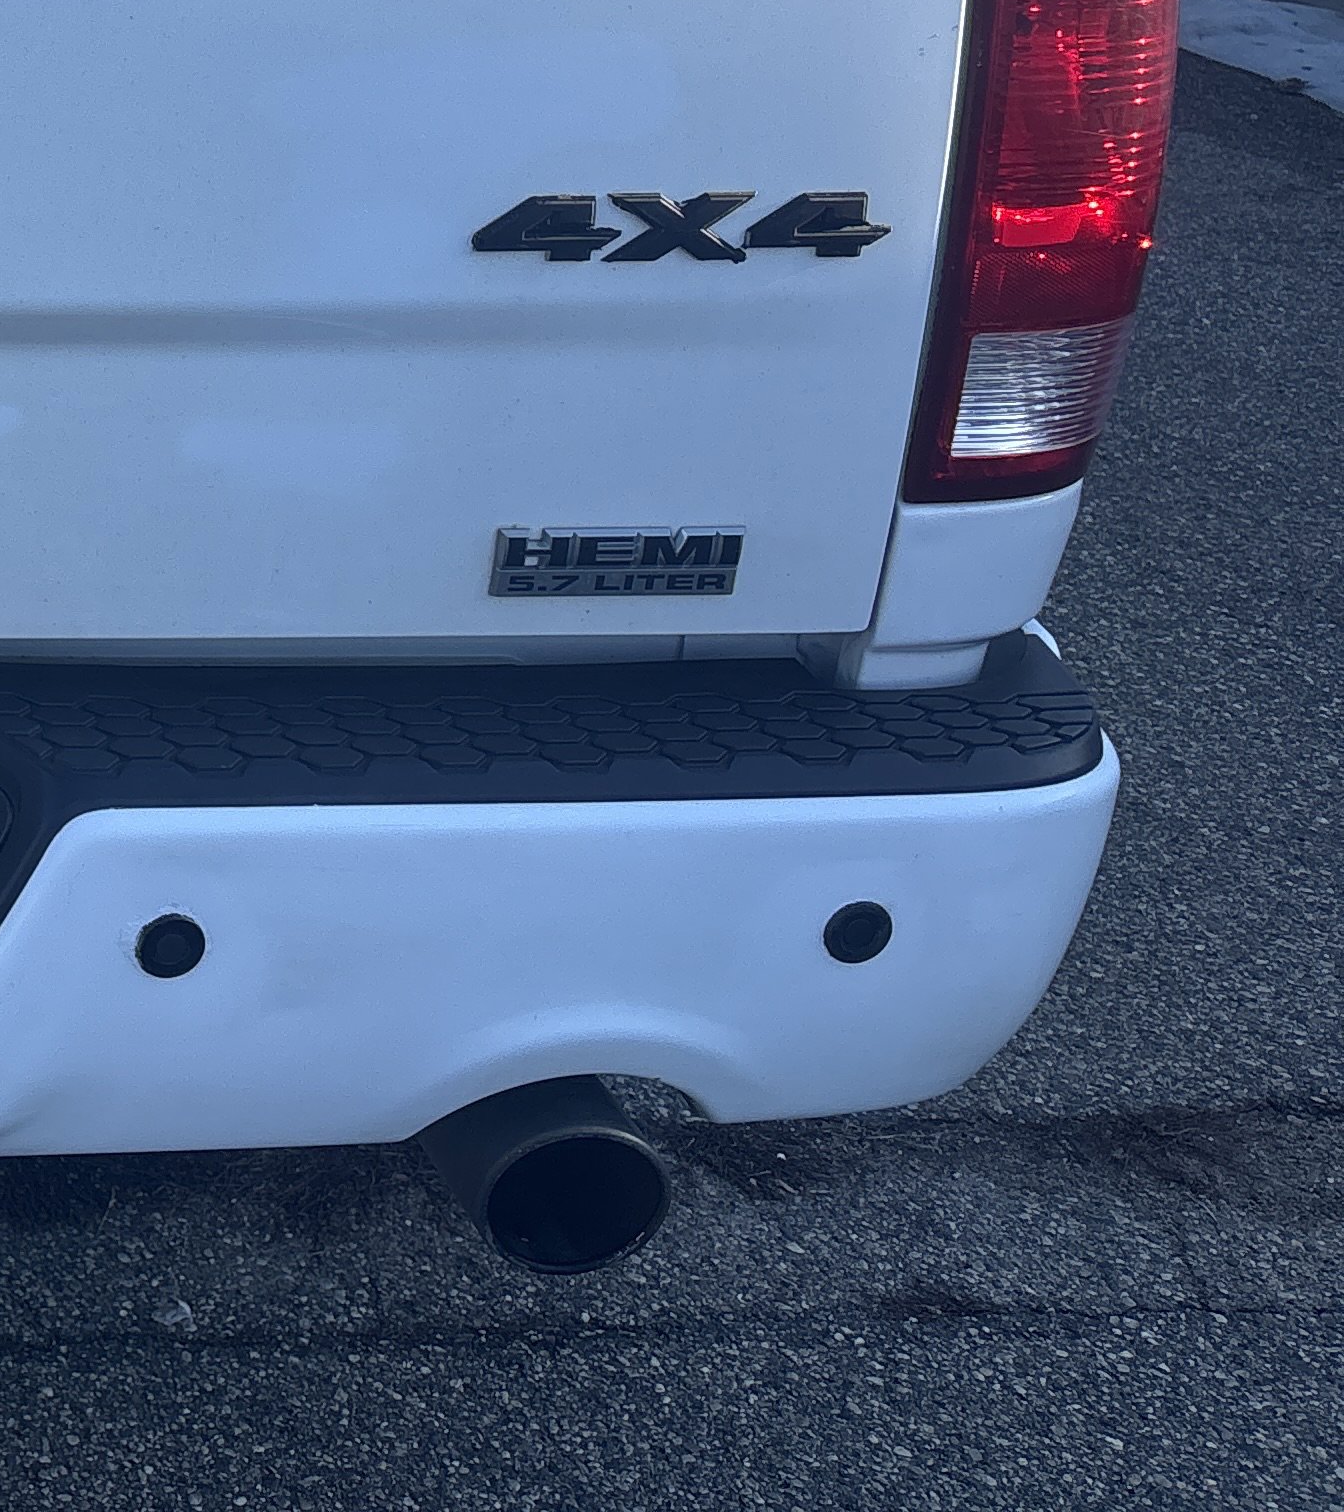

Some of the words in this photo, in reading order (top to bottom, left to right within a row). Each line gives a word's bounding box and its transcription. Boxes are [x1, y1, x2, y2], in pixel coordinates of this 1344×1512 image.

[471, 190, 893, 264] 4X4
[495, 525, 746, 570] HEMI
[506, 574, 579, 592] 5.7
[593, 573, 727, 592] LITER
